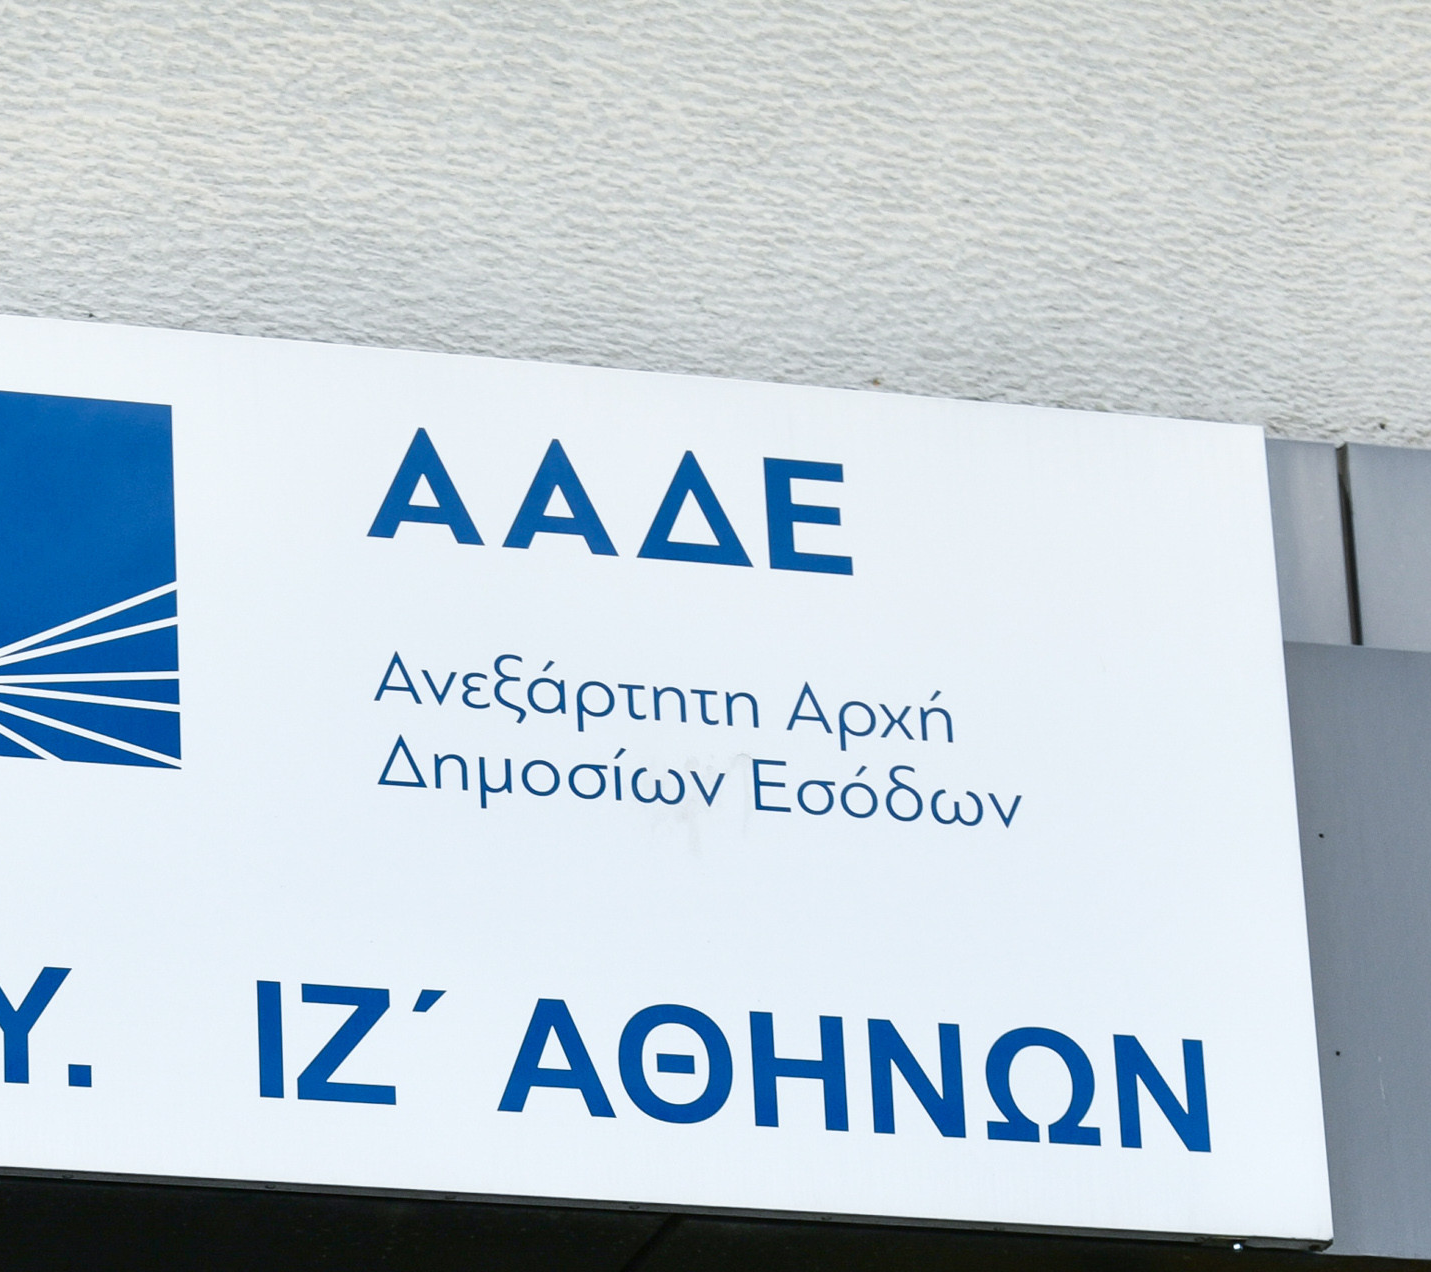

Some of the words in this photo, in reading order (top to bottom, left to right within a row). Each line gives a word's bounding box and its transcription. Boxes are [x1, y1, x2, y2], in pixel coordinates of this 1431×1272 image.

[368, 428, 853, 575] ΑΑΔΕ
[375, 652, 759, 742] Ανεξάρτητη
[789, 681, 954, 747] Αρχή
[378, 734, 723, 812] Δημοσίων
[751, 742, 1021, 828] Εσόδων
[498, 999, 1211, 1152] ΑΘΗΝΩΝ
